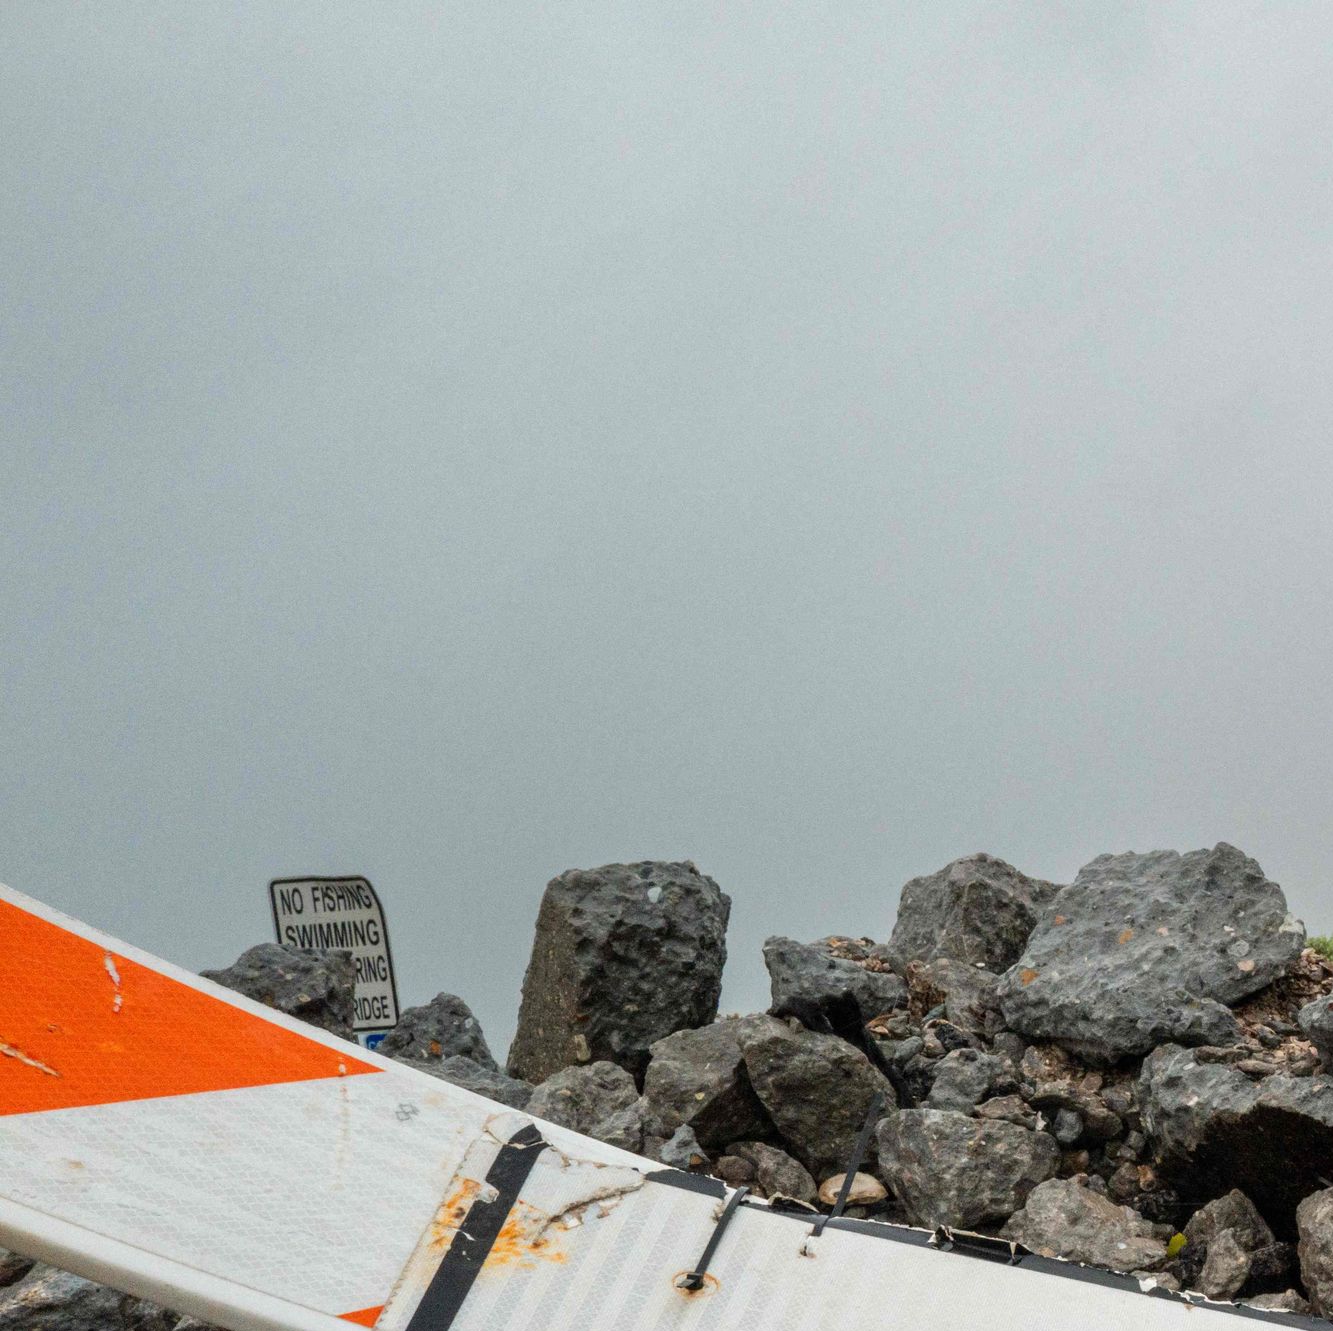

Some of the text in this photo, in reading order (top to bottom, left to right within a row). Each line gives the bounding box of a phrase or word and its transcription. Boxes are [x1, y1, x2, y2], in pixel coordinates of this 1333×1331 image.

[280, 885, 372, 915] NO FISHING
[285, 919, 380, 948] SWIMMING
[352, 995, 390, 1021] RIDGE
